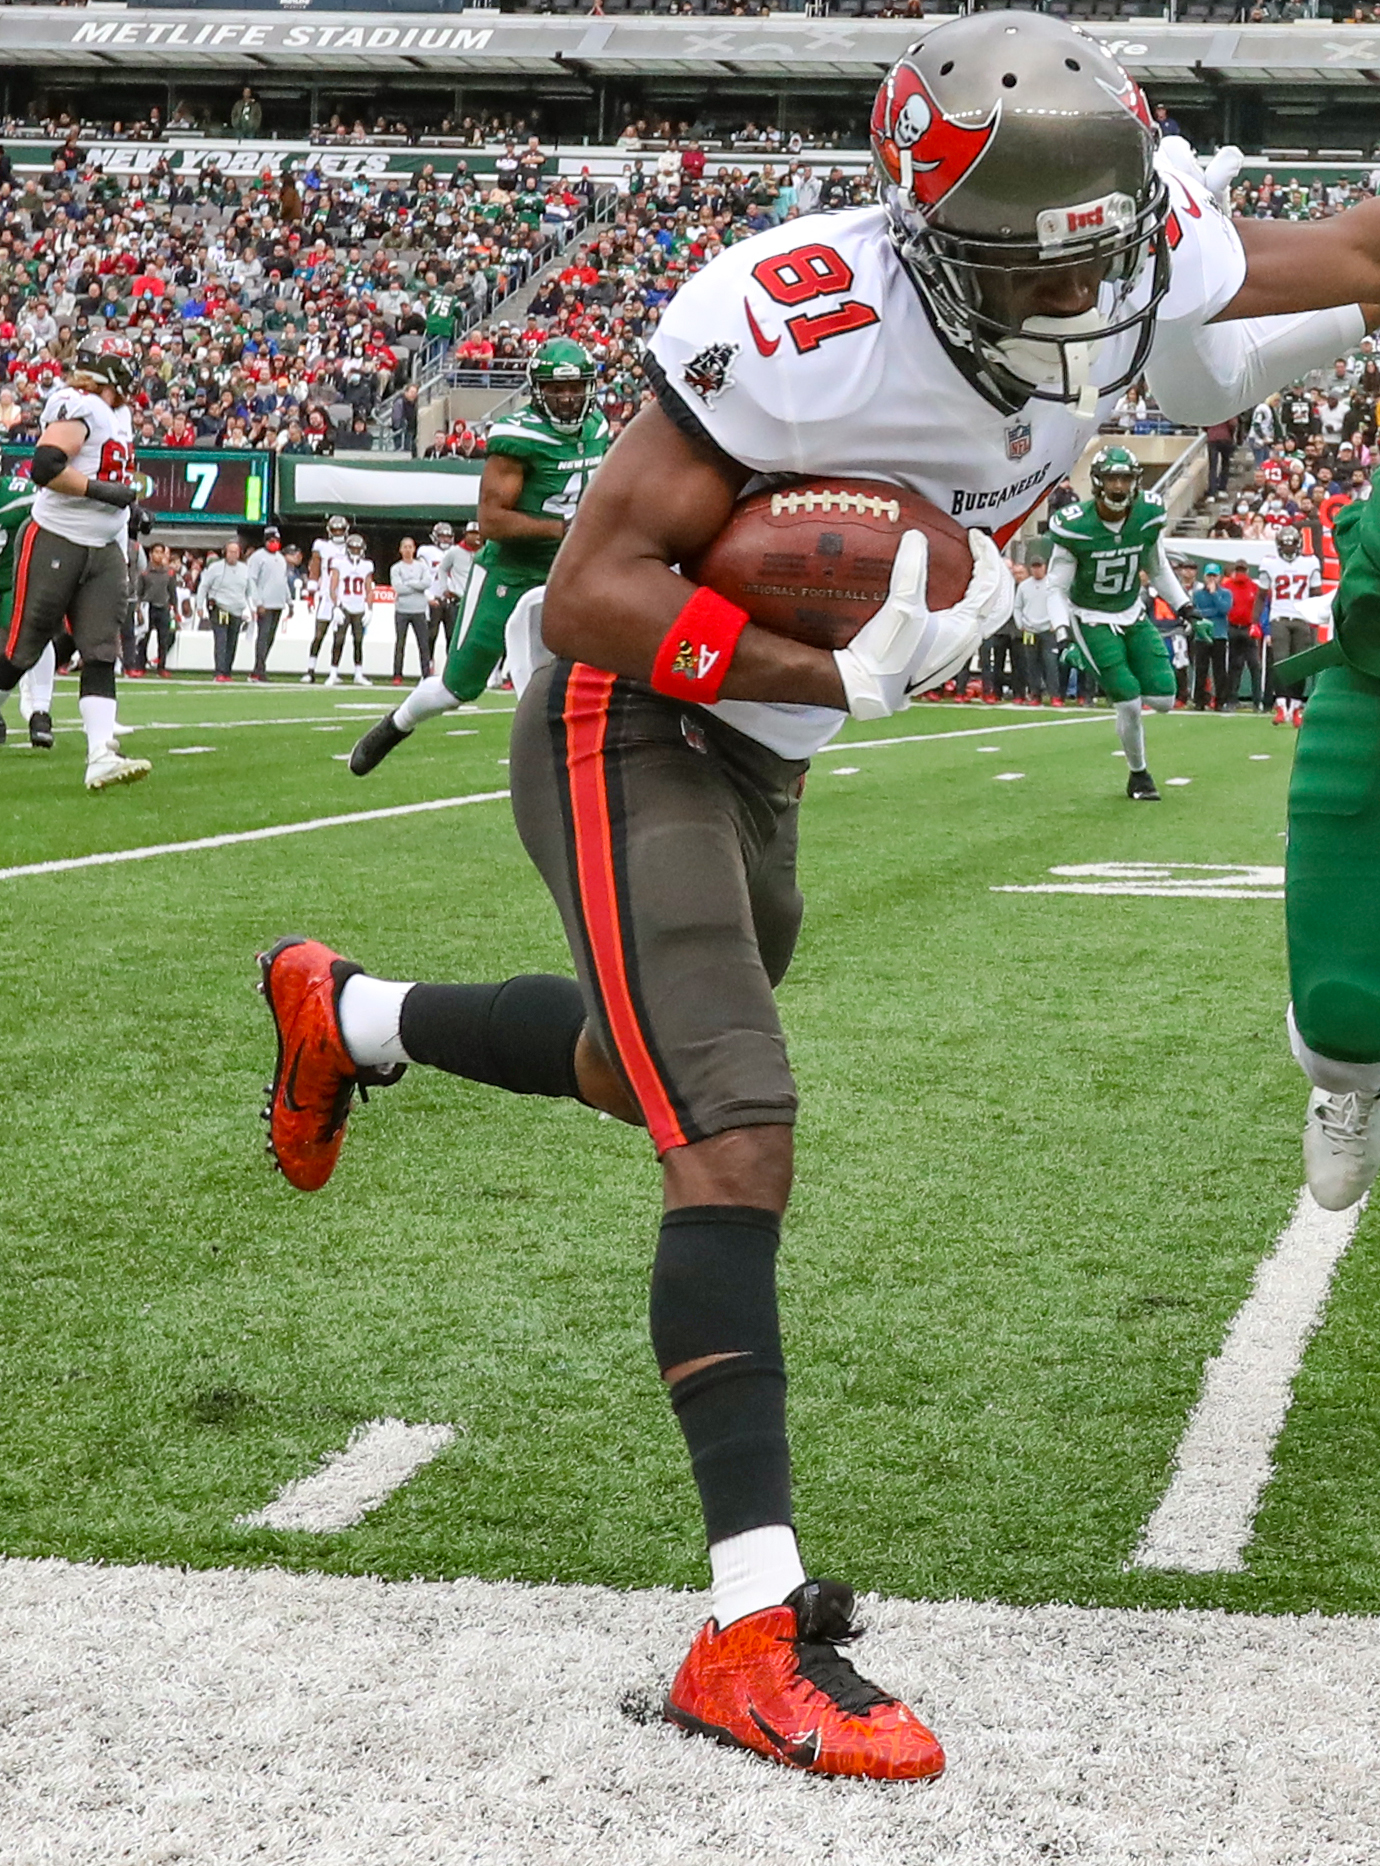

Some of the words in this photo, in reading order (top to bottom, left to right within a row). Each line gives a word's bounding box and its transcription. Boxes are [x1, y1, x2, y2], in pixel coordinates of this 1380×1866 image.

[71, 22, 274, 46] METLIFE
[282, 26, 494, 50] STADIUM
[85, 149, 167, 168] NEW
[179, 151, 291, 170] YORK
[431, 299, 451, 317] 75
[751, 243, 882, 356] 81
[185, 462, 219, 510] 7
[343, 577, 364, 595] 10
[1092, 554, 1139, 595] 51
[1275, 575, 1308, 600] 27
